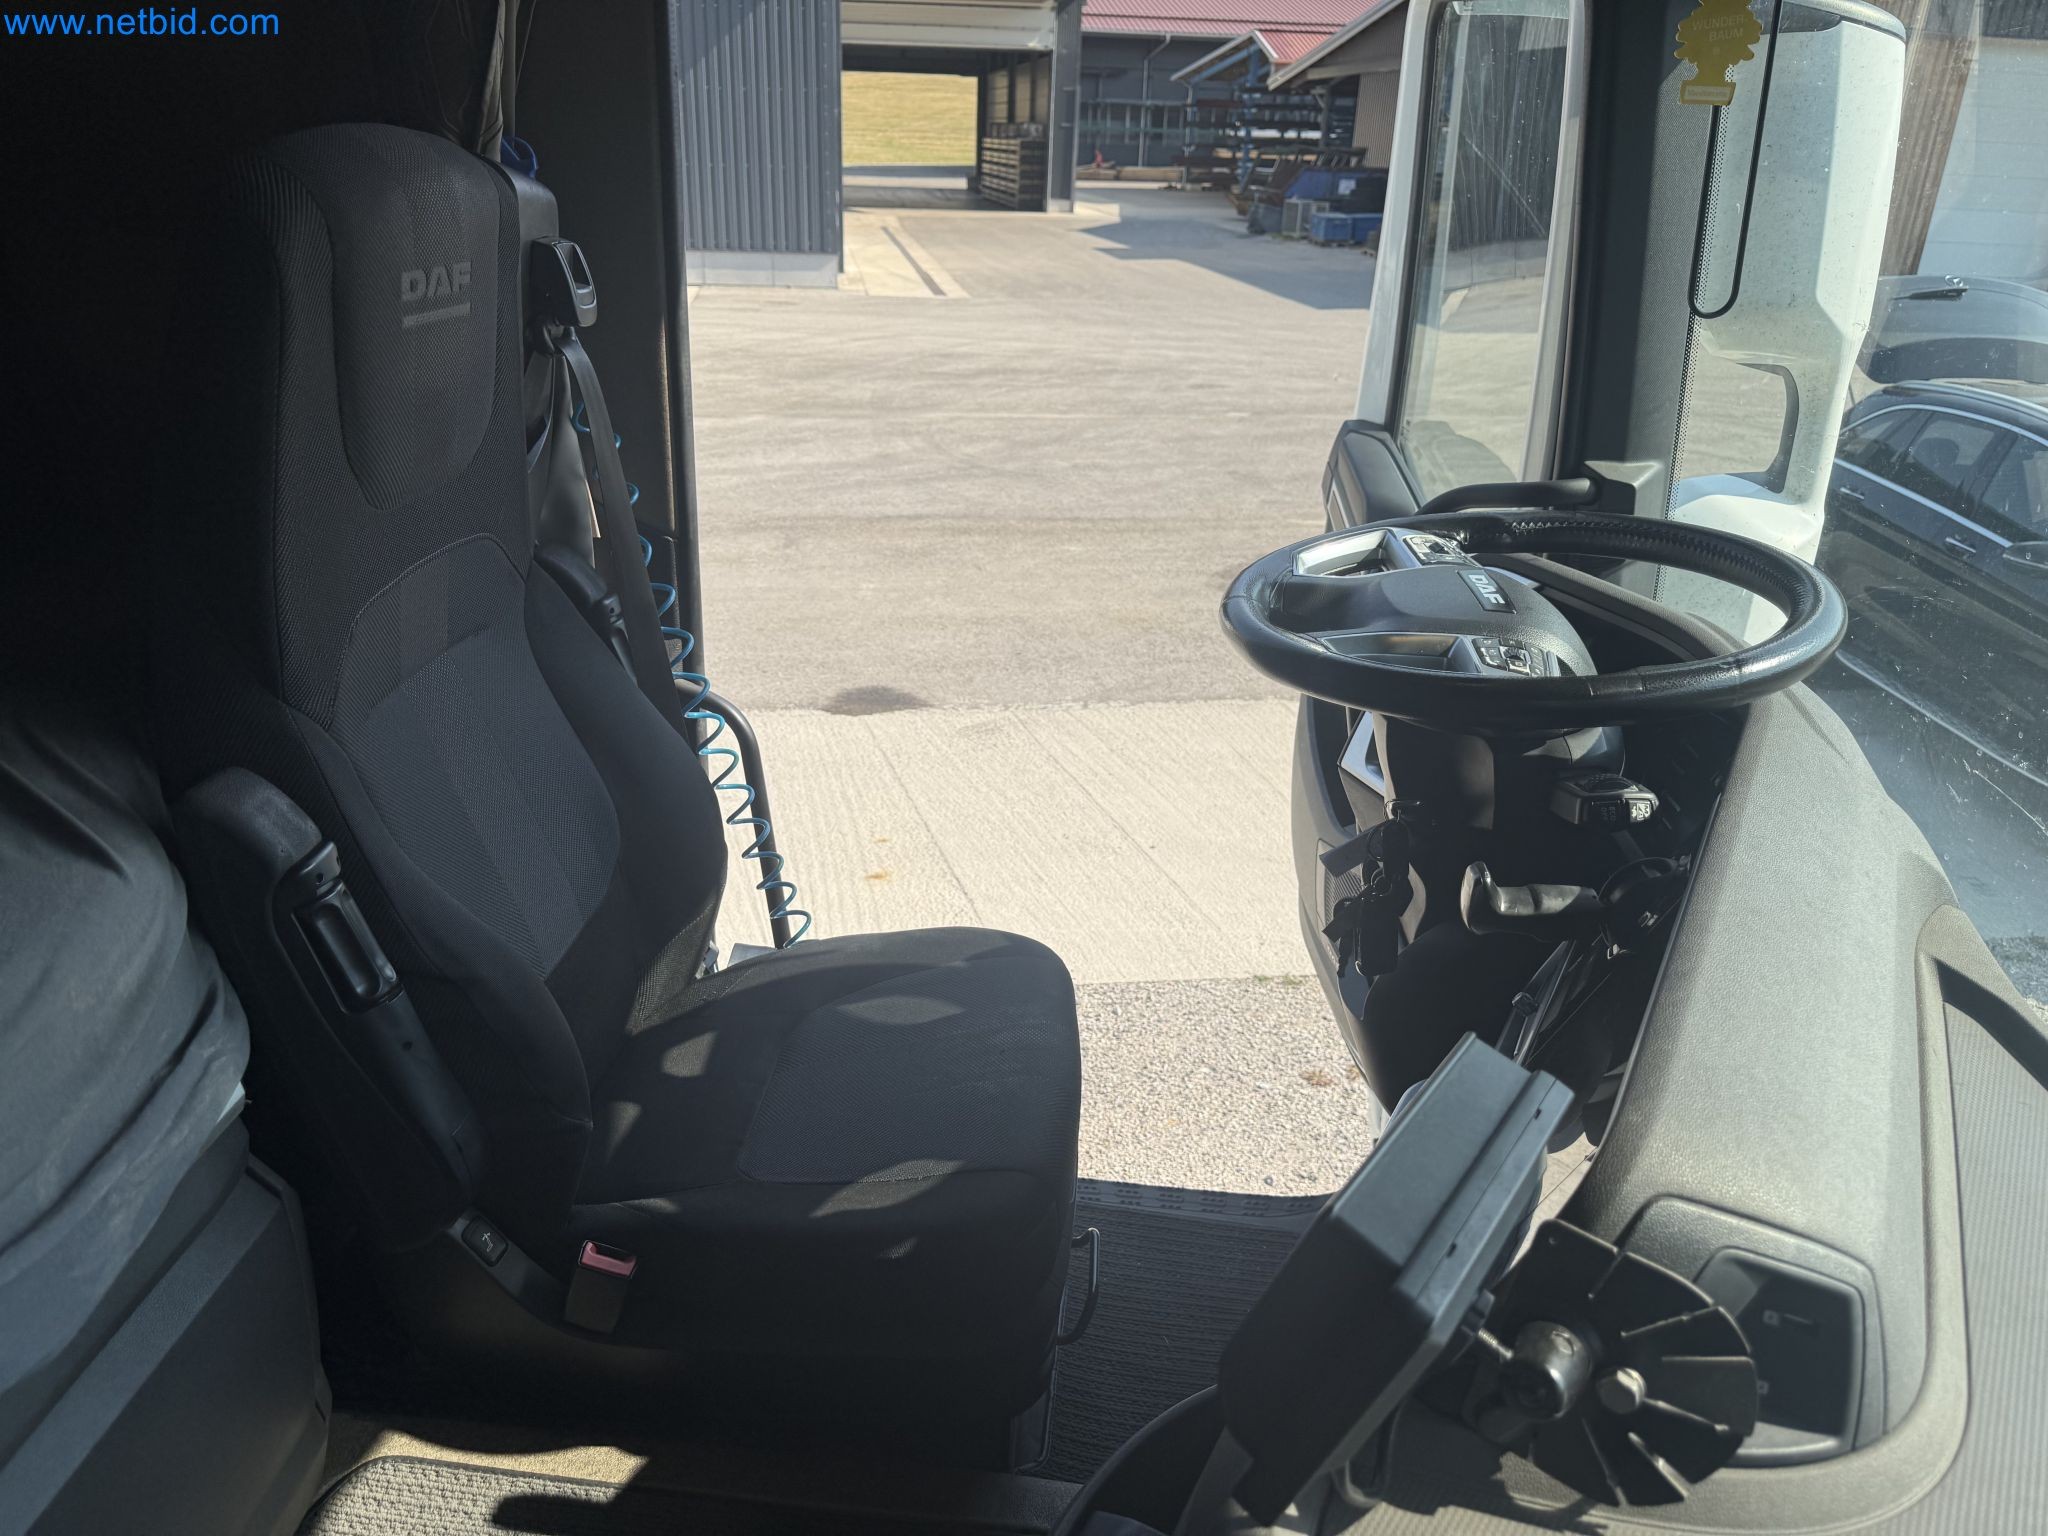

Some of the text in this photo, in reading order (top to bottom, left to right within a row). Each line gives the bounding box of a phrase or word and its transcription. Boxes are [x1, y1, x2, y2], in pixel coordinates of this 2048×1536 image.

[1709, 27, 1744, 42] BAUM
[401, 262, 472, 302] DAF
[1468, 574, 1506, 605] DAF
